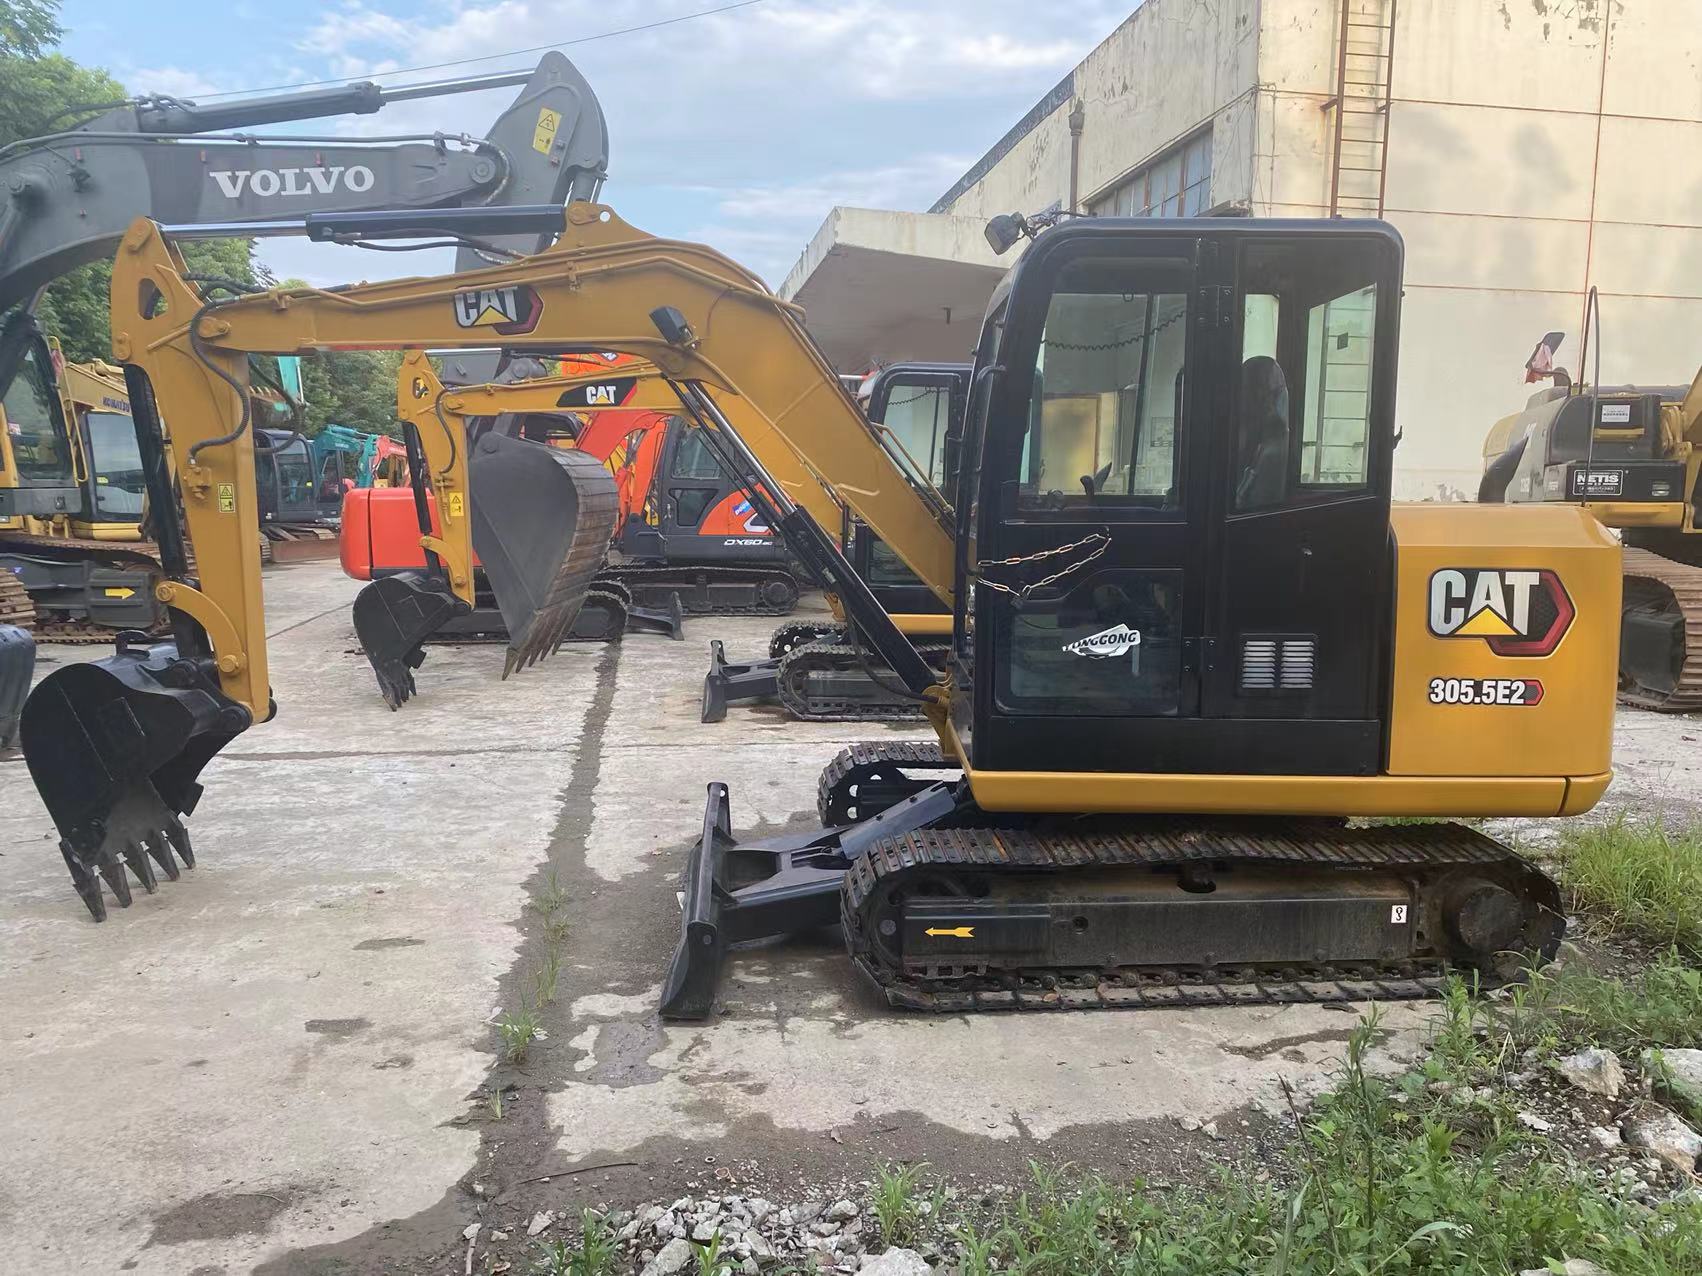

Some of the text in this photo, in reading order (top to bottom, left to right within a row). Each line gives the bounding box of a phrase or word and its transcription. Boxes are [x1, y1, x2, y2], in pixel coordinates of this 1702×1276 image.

[209, 165, 375, 198] VOLVO
[454, 285, 518, 327] CAT
[586, 385, 616, 405] CAT
[1576, 474, 1619, 483] NETIS
[1430, 569, 1540, 636] CAT
[1429, 678, 1526, 704] 305.5E2
